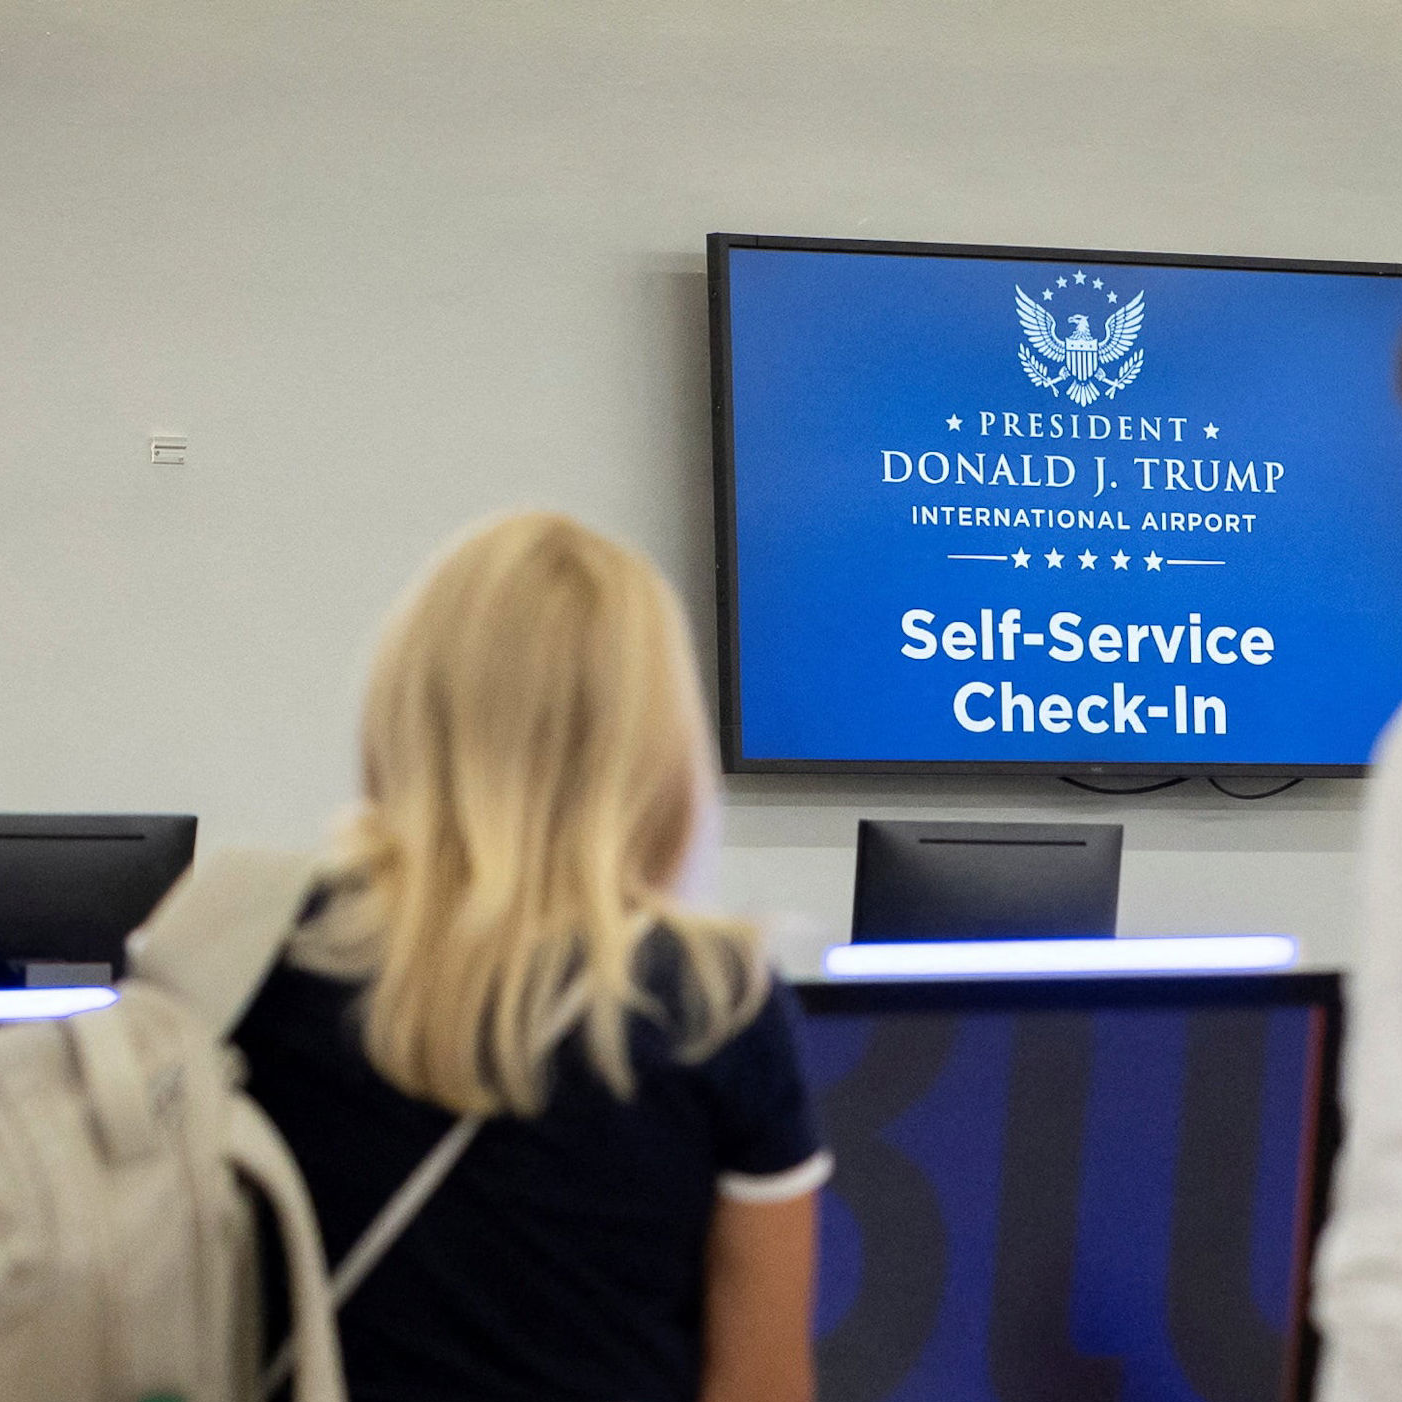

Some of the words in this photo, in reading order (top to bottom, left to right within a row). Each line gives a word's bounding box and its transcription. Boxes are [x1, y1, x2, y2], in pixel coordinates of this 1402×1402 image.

[979, 411, 1188, 442] PRESIDENT
[880, 450, 1075, 487] DONALD
[1094, 457, 1118, 497] J.
[1134, 457, 1285, 494] TRUMP
[911, 506, 1131, 530] INTERNATIONAL
[1142, 512, 1257, 533] AIRPORT
[900, 609, 1275, 665] Self-Service
[953, 682, 1227, 734] Check-In
